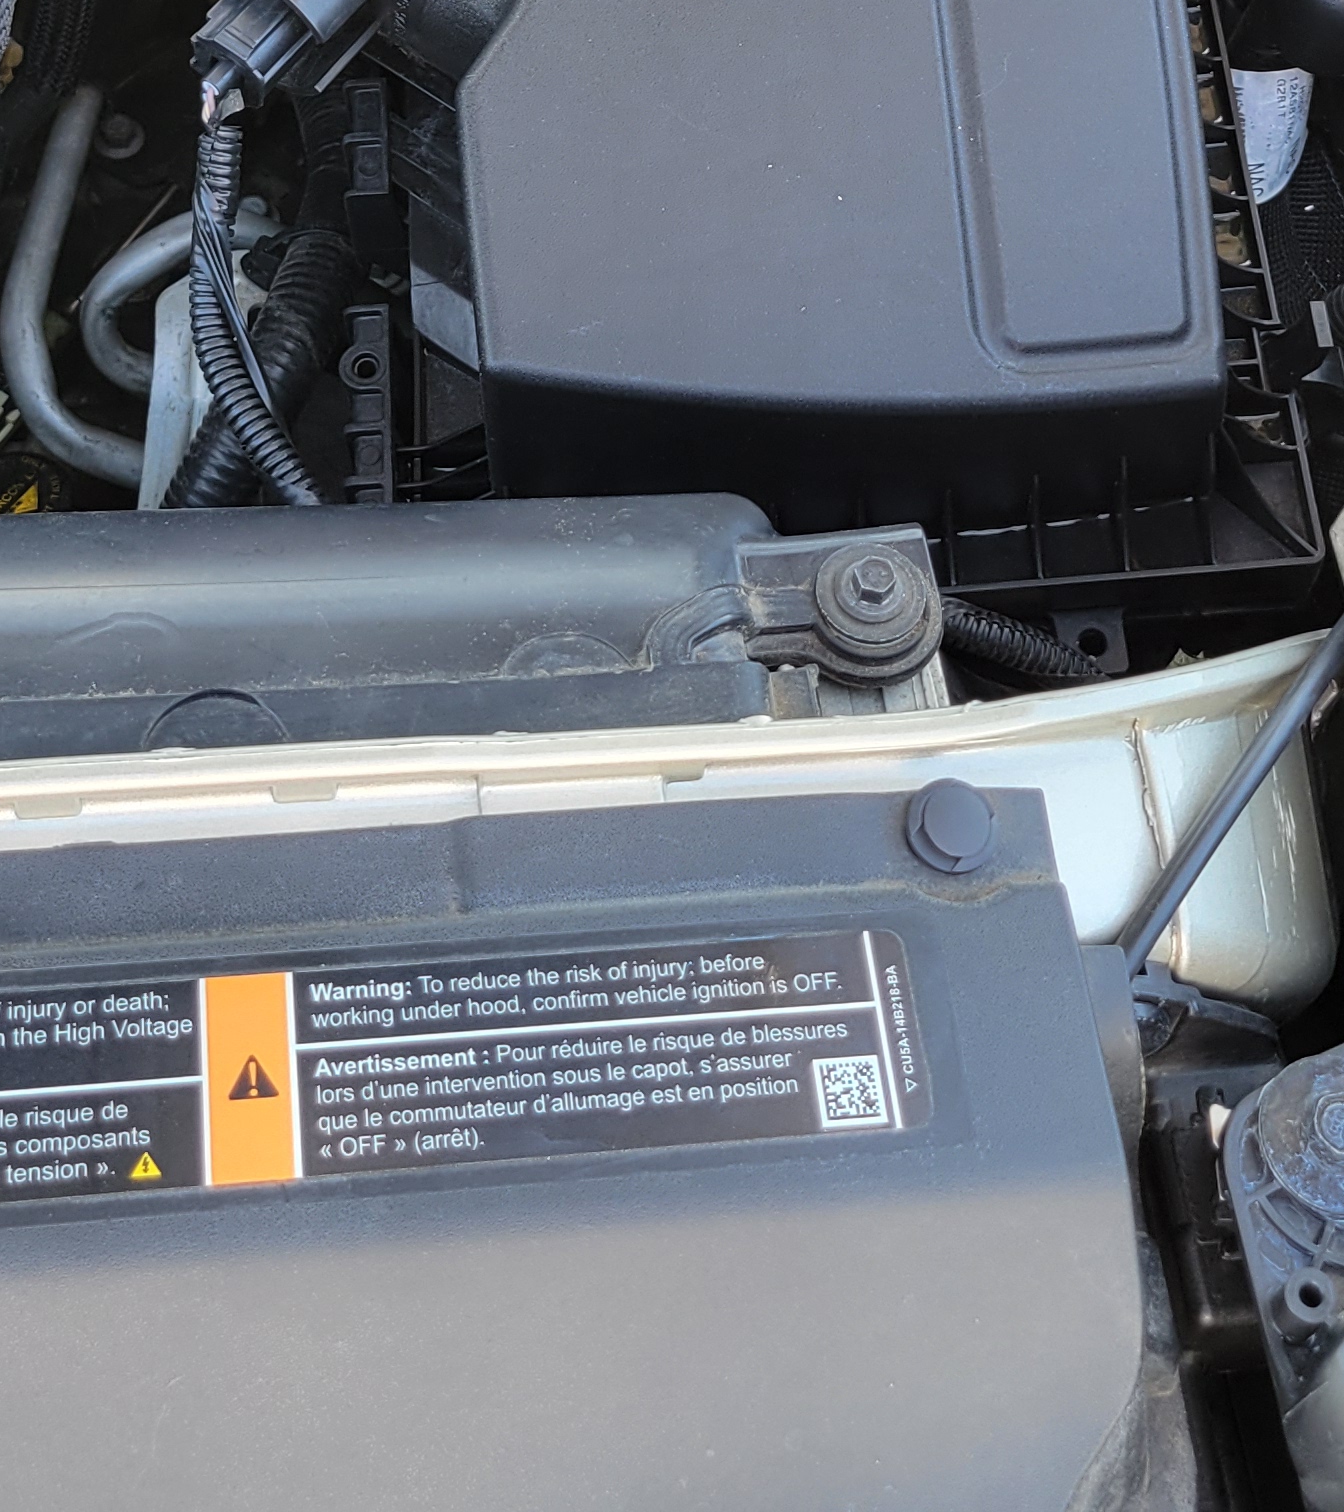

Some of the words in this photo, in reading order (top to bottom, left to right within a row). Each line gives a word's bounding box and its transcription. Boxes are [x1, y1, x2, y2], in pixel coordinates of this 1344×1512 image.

[311, 979, 412, 1003] Warning:
[418, 975, 443, 995] To
[450, 971, 521, 992] reduce
[527, 968, 560, 987] the
[566, 963, 602, 983] risk
[608, 961, 628, 980] of
[632, 958, 696, 982] injury;
[700, 953, 765, 974] before
[8, 999, 66, 1024] injury
[73, 999, 96, 1016] or
[103, 991, 170, 1014] death;
[312, 1005, 394, 1029] working
[401, 1000, 461, 1022] under
[467, 995, 526, 1016] hood,
[533, 988, 609, 1012] confirm
[614, 983, 687, 1006] vehicle
[692, 977, 765, 1005] ignition
[771, 976, 788, 995] is
[793, 971, 843, 992] OFF.
[885, 964, 914, 1075] CU5A-14B218-BA
[13, 1025, 48, 1046] the
[55, 1022, 105, 1047] High
[112, 1017, 194, 1040] Voltage
[314, 1047, 476, 1078] Avertissement
[496, 1043, 545, 1064] Pour
[551, 1036, 623, 1060] réduire
[628, 1034, 647, 1054] le
[653, 1031, 714, 1054] risque
[720, 1027, 746, 1047] de
[752, 1020, 848, 1045] blessures
[316, 1084, 355, 1105] lors
[361, 1079, 419, 1101] d'une
[426, 1070, 546, 1096] intervention
[553, 1065, 602, 1087] sous
[606, 1062, 626, 1082] le
[631, 1057, 694, 1082] capot,
[700, 1050, 793, 1075] s'assurer
[0, 1108, 18, 1128] le
[26, 1105, 94, 1127] risque
[101, 1100, 128, 1120] de
[318, 1112, 358, 1135] que
[364, 1107, 383, 1128] le
[390, 1097, 527, 1126] commutateur
[652, 1083, 682, 1104] est
[688, 1084, 714, 1102] en
[720, 1075, 799, 1103] position
[15, 1126, 151, 1156] composants
[340, 1133, 387, 1157] OFF
[414, 1127, 485, 1155] (arrêt).
[6, 1160, 88, 1184] tension
